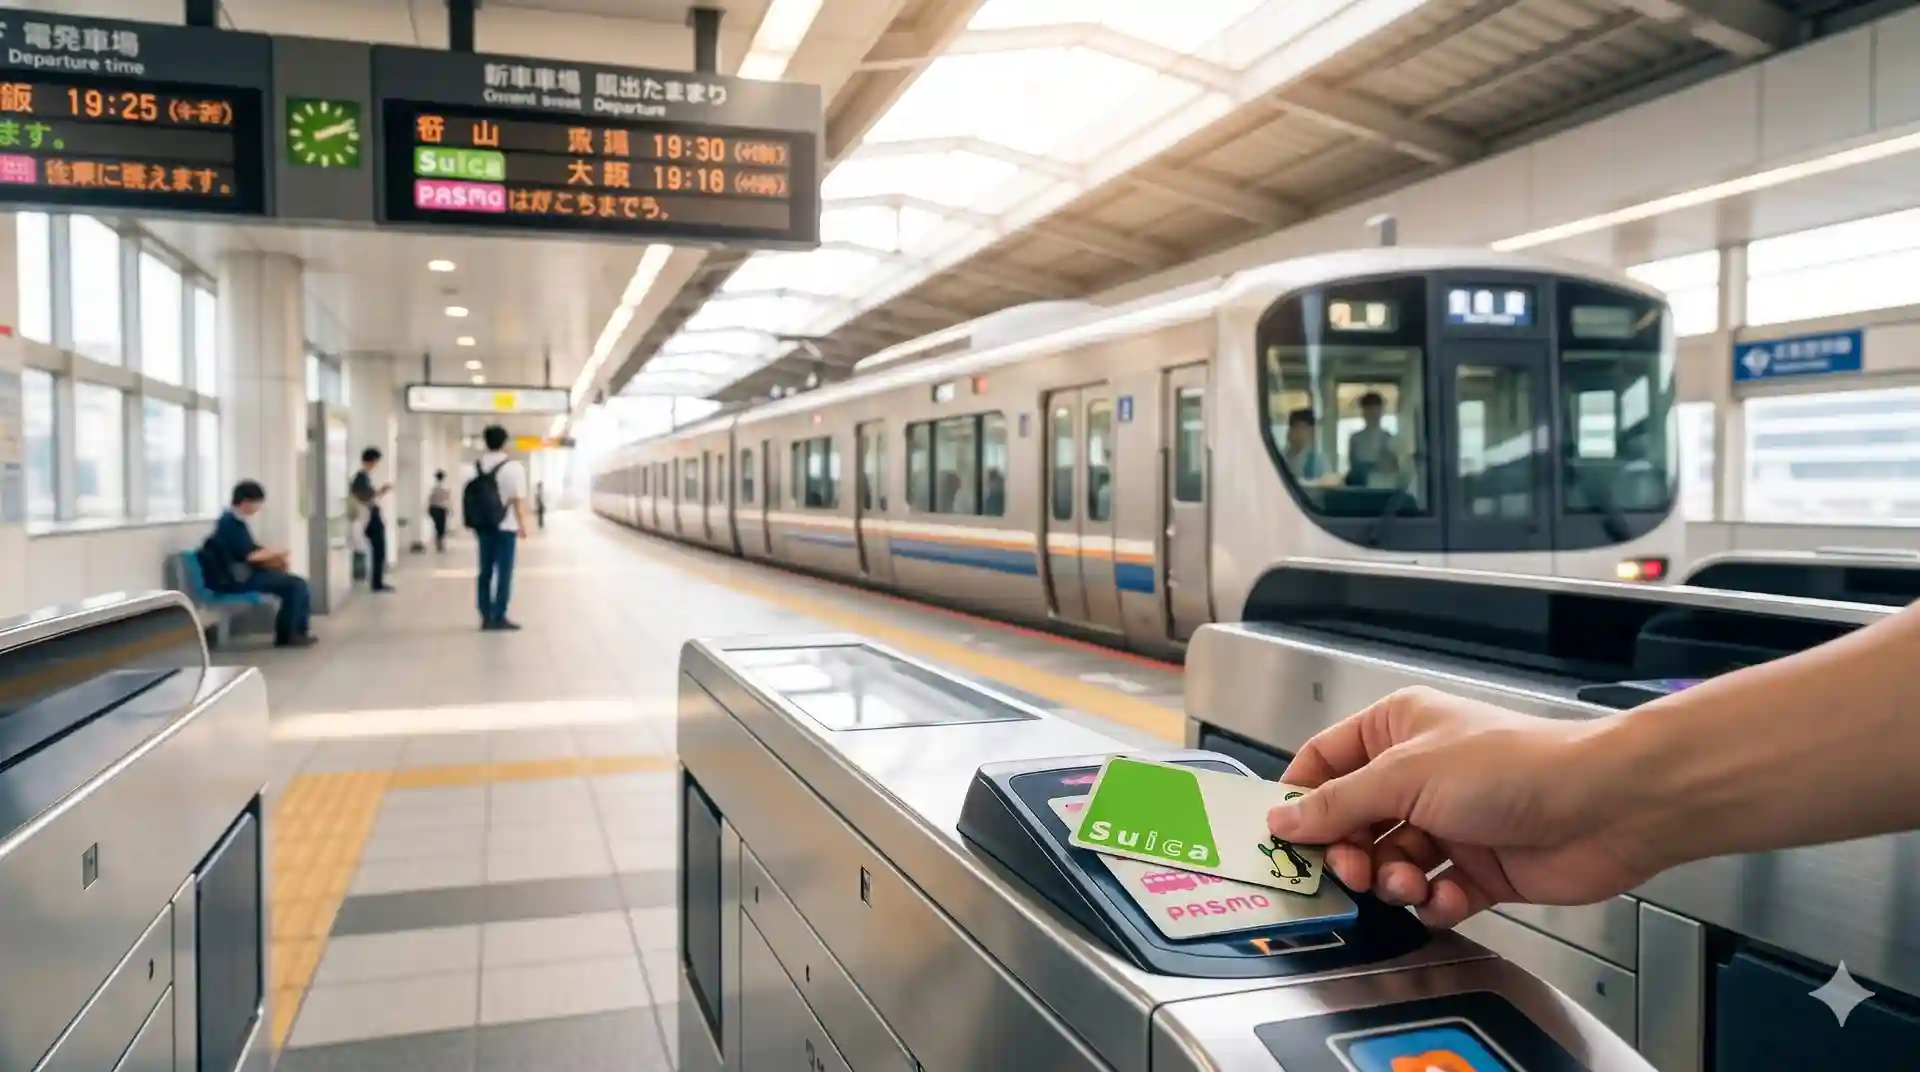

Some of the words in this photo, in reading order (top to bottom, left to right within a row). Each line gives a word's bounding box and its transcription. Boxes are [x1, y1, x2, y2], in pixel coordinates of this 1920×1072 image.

[9, 48, 100, 70] Departure
[104, 58, 145, 75] time
[67, 87, 158, 121] 19:25
[653, 133, 726, 162] 19:30
[418, 151, 501, 179] Suica
[418, 185, 503, 207] PASMO
[1088, 821, 1209, 861] Suica
[1165, 894, 1271, 922] PASMO
